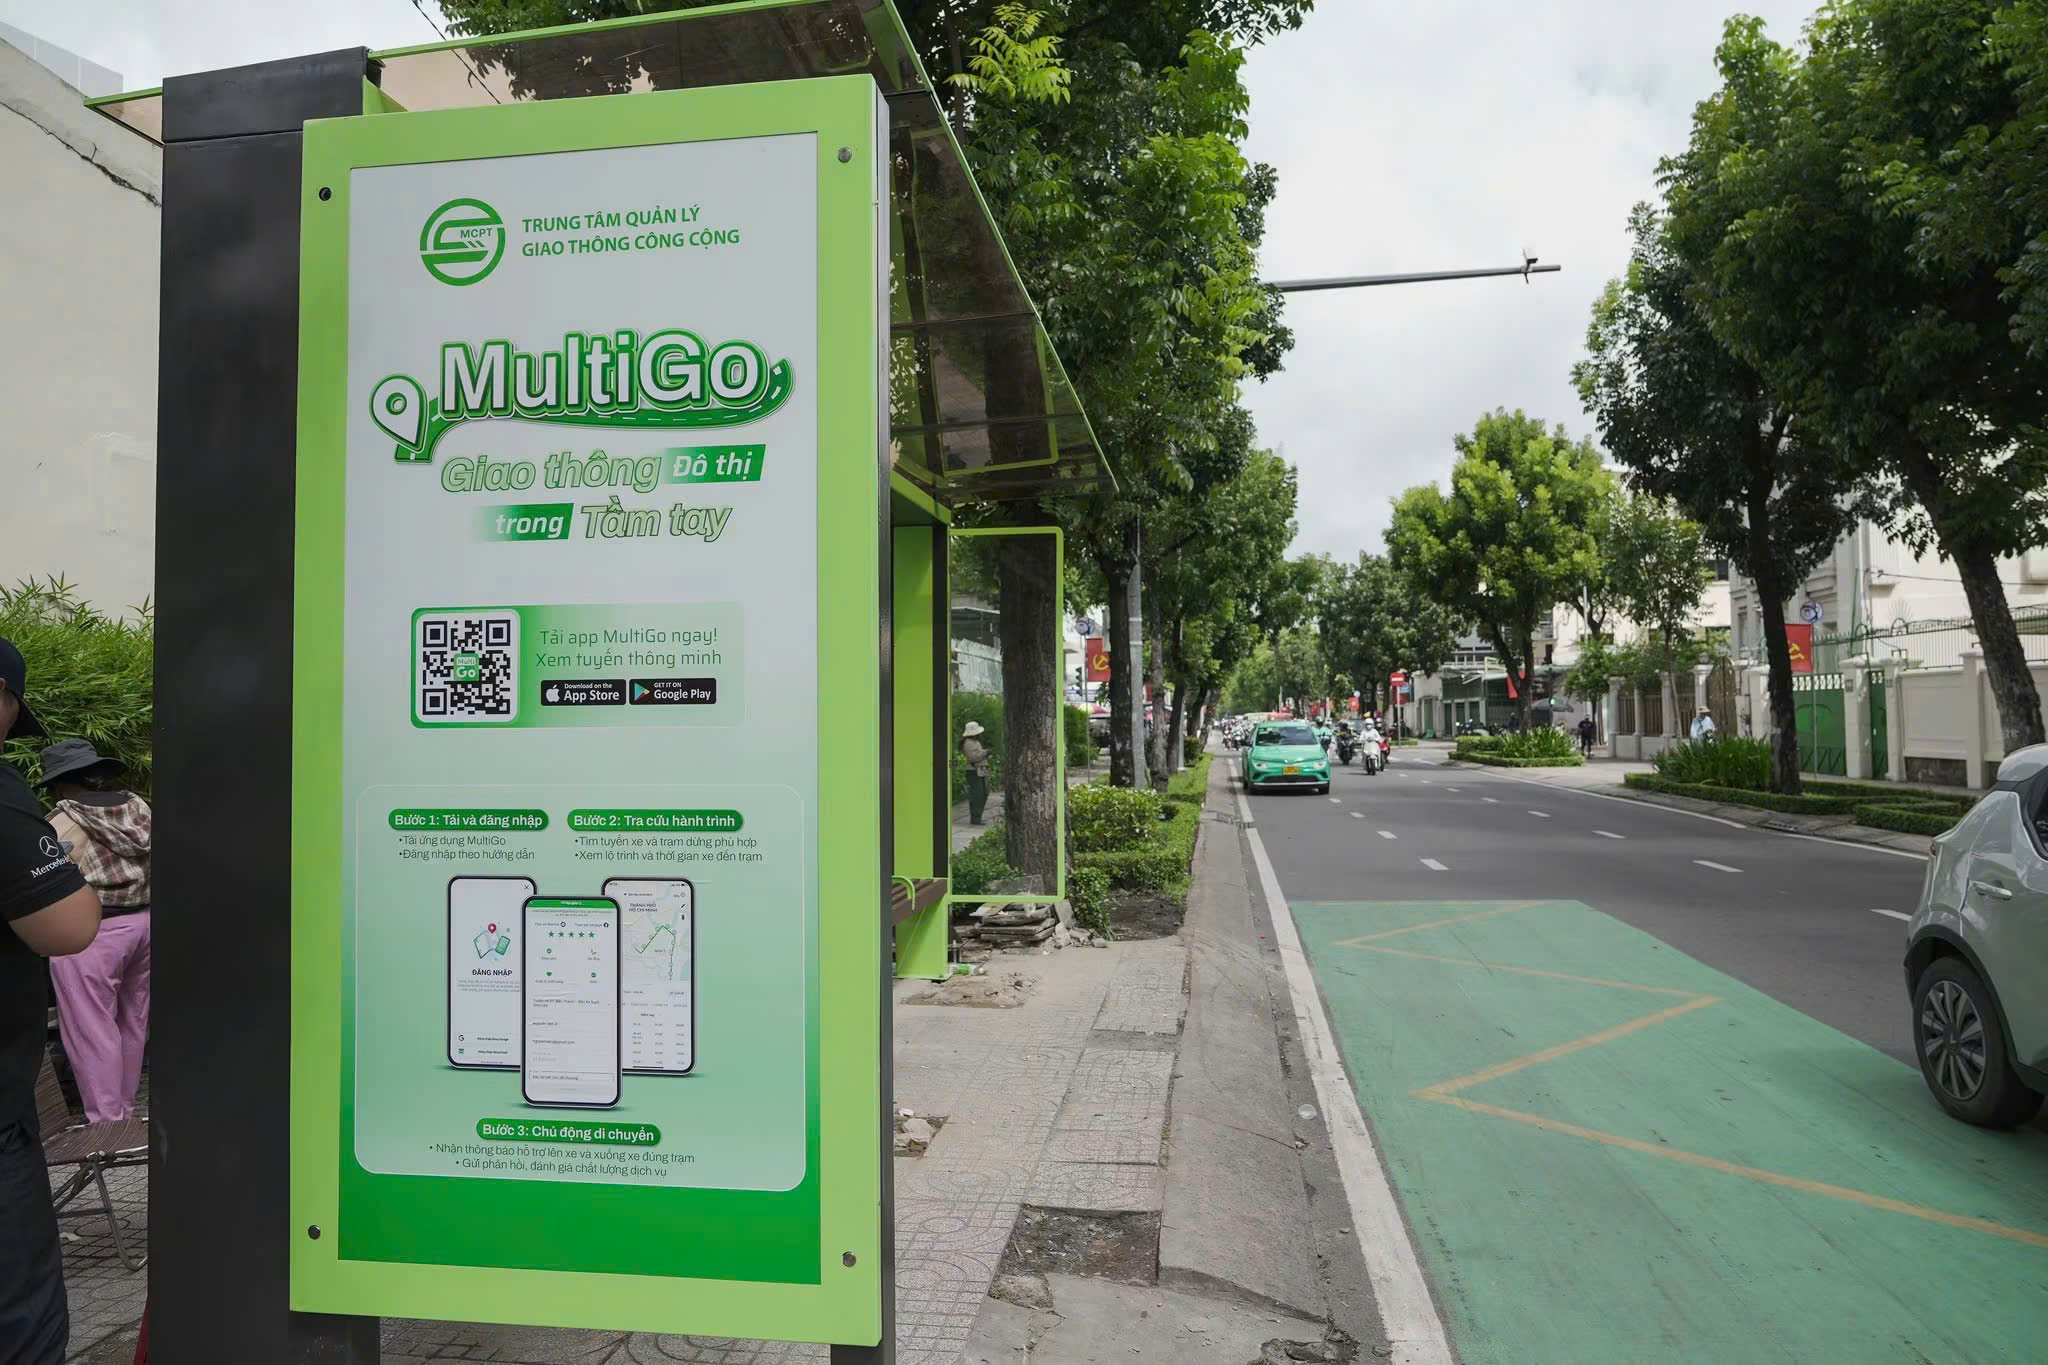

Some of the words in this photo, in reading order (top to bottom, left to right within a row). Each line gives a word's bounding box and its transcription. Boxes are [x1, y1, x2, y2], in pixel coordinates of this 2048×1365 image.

[522, 215, 581, 234] TRUNG
[584, 210, 621, 229] TÂM
[625, 204, 676, 226] QUẢN
[681, 205, 700, 223] LÝ
[460, 228, 492, 239] MCPT
[522, 239, 564, 257] GIAO
[568, 233, 630, 254] THÔNG
[634, 232, 684, 250] CÔNG
[689, 229, 740, 251] CỘNG
[441, 329, 770, 420] MultiGo
[441, 455, 535, 493] Giao
[544, 450, 662, 492] thông
[672, 453, 707, 477] Đô
[715, 451, 753, 481] thị
[495, 512, 564, 539] trong
[580, 496, 661, 540] Tầm
[669, 503, 732, 542] tay
[540, 628, 564, 645] Tải
[568, 632, 598, 647] app
[603, 627, 667, 644] MultiGo
[671, 628, 718, 645] ngay!
[535, 652, 571, 668] Xem
[576, 647, 623, 669] tuyến
[627, 649, 676, 669] thông
[681, 650, 721, 665] minh
[456, 667, 476, 678] Go
[563, 689, 587, 704] App
[589, 688, 620, 701] Store
[654, 689, 688, 702] Google
[690, 688, 712, 701] Play
[395, 815, 426, 825] Bước
[429, 815, 440, 825] 1:
[443, 814, 460, 825] Tải
[462, 814, 477, 825] và
[479, 814, 510, 828] đăng
[512, 815, 543, 828] nhập
[574, 815, 606, 826] Bước
[609, 815, 621, 826] 2:
[624, 815, 644, 826] Tra
[646, 815, 669, 827] cứu
[672, 815, 703, 827] hành
[706, 815, 735, 827] trình
[403, 836, 417, 845] Tải
[419, 836, 438, 846] ứng
[440, 836, 465, 846] dụng
[467, 836, 506, 846] MultiGo
[600, 834, 629, 848] tuyến
[645, 838, 658, 847] và
[660, 838, 684, 848] trạm
[686, 837, 713, 849] dừng
[737, 839, 757, 849] hợp
[403, 849, 430, 860] Đăng
[431, 849, 456, 860] nhập
[458, 850, 480, 860] theo
[482, 850, 514, 862] hướng
[515, 848, 535, 860] dẫn
[579, 850, 602, 860] Xem
[605, 851, 615, 861] lộ
[617, 851, 640, 861] trình
[641, 851, 653, 861] và
[655, 851, 675, 861] thời
[677, 852, 700, 863] gian
[716, 849, 736, 862] đến
[738, 852, 763, 864] trạm
[472, 968, 492, 976] ĐĂNG
[493, 969, 513, 978] NHẬP
[482, 1124, 515, 1136] Bước
[517, 1125, 529, 1137] 3:
[532, 1125, 557, 1137] Chủ
[560, 1127, 592, 1141] động
[594, 1128, 606, 1140] di
[608, 1126, 654, 1143] chuyển
[436, 1143, 463, 1154] Nhận
[465, 1145, 495, 1156] thông
[496, 1146, 515, 1157] báo
[517, 1144, 530, 1157] hỗ
[532, 1148, 545, 1158] trợ
[548, 1147, 563, 1158] lên
[580, 1149, 593, 1160] và
[594, 1147, 626, 1162] xuống
[628, 1153, 641, 1161] xe
[642, 1150, 669, 1164] đúng
[671, 1152, 695, 1165] trạm
[462, 1157, 481, 1168] Gửi
[530, 1161, 556, 1172] đánh
[558, 1162, 573, 1175] giá
[600, 1163, 629, 1177] lượng
[631, 1165, 652, 1178] dịch
[655, 1168, 667, 1178] vụ
